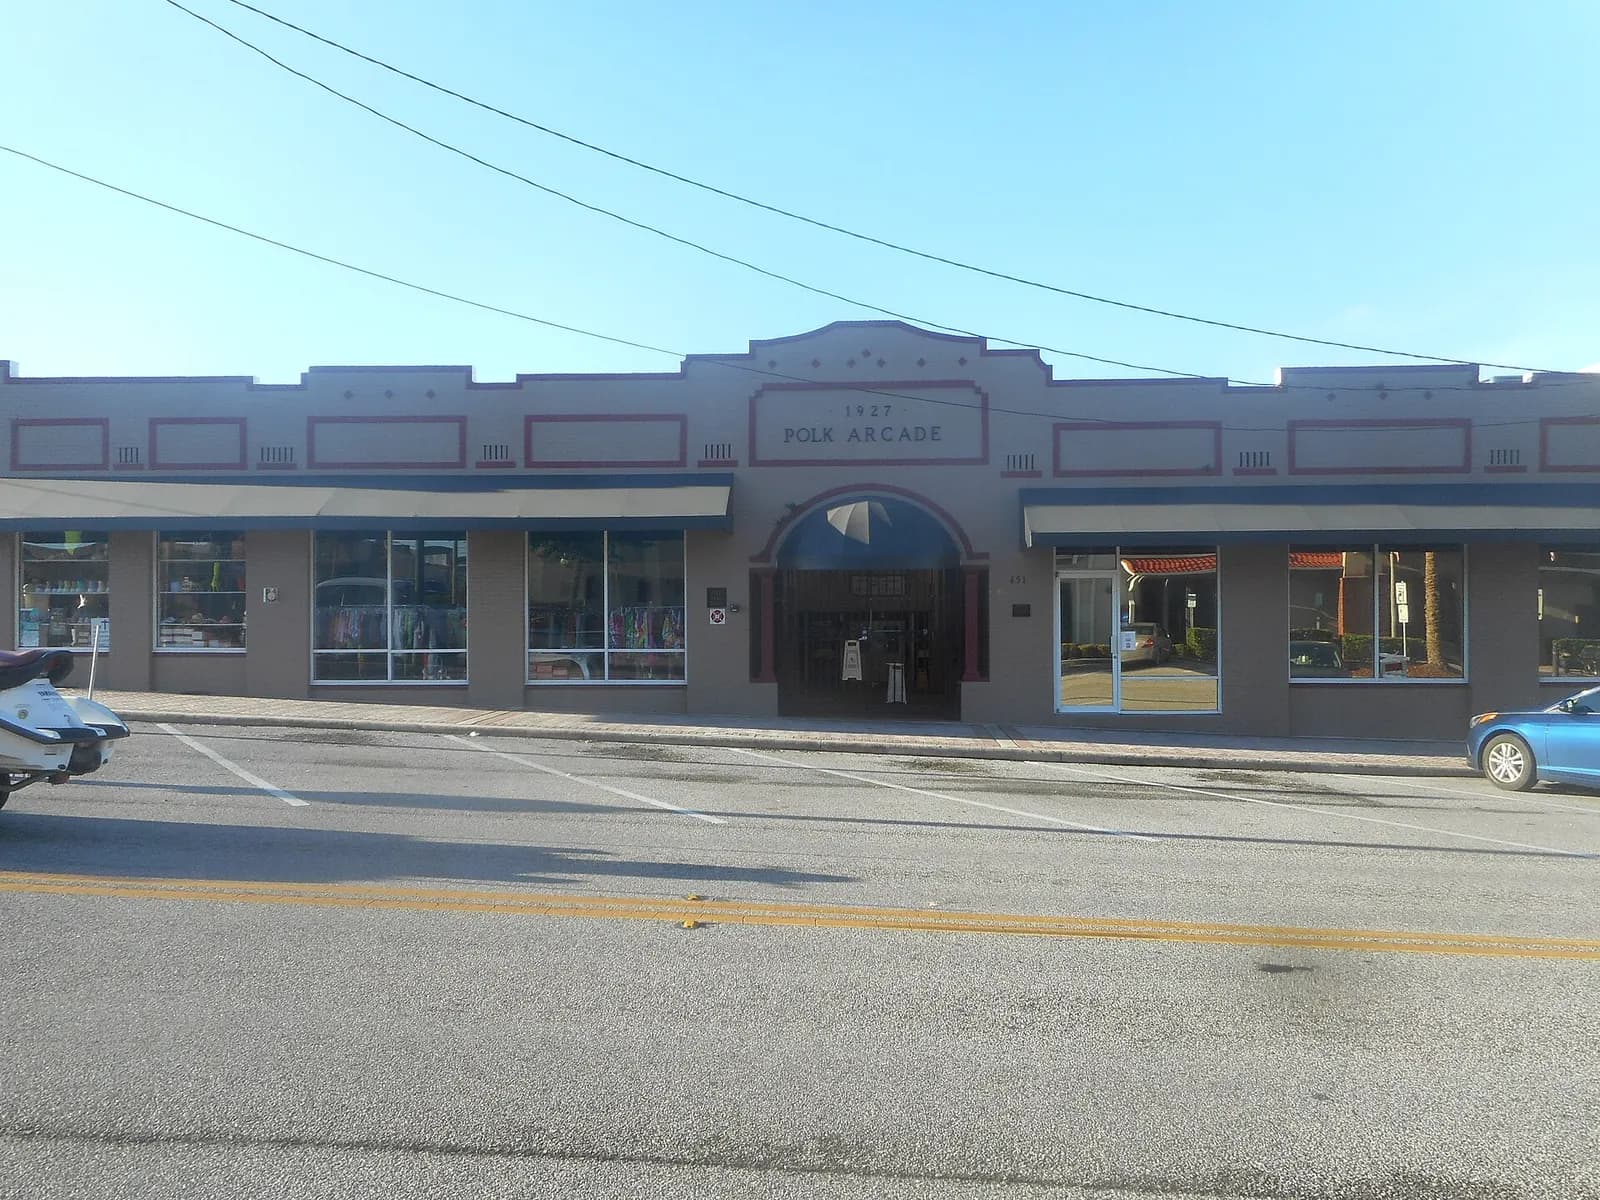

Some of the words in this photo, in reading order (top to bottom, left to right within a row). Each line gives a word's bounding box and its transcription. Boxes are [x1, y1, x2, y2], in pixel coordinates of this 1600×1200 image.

[845, 405, 892, 417] 1927
[784, 427, 834, 443] POLK
[848, 426, 942, 442] ARCADE
